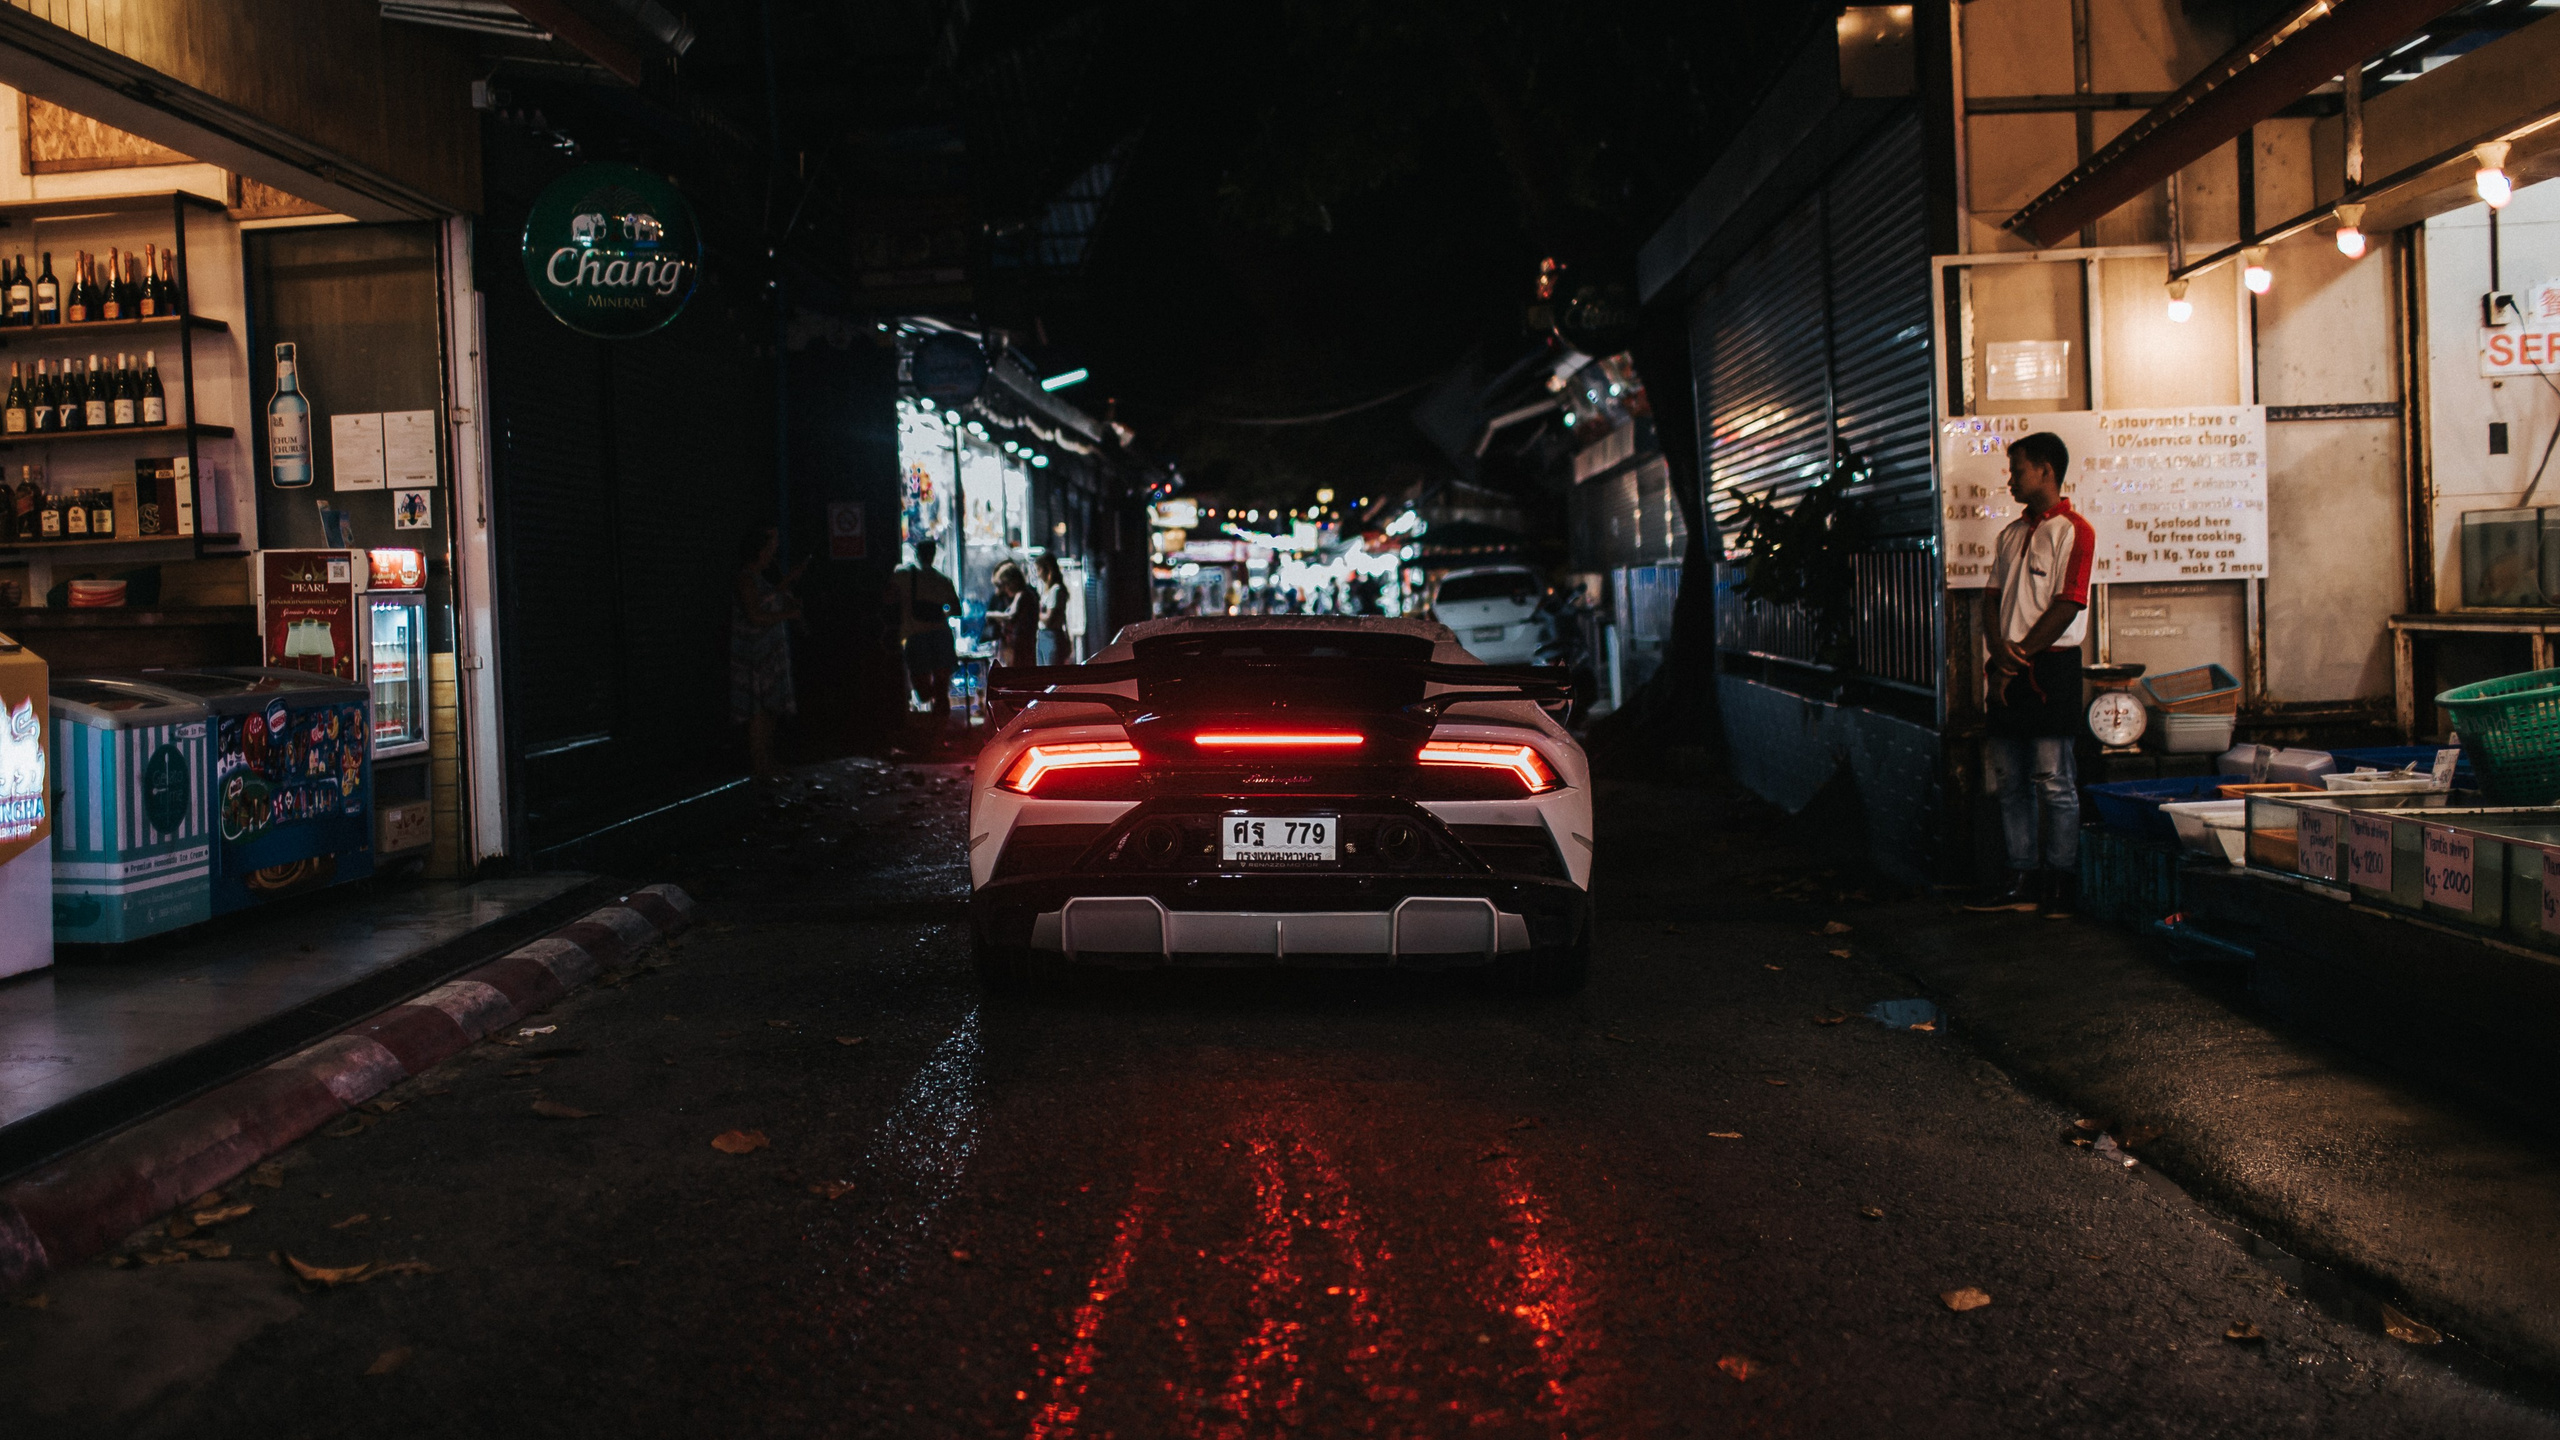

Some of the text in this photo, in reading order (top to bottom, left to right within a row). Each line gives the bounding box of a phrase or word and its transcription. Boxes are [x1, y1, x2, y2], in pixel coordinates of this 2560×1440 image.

[547, 247, 682, 295] Chang
[588, 295, 647, 308] MINERAL
[273, 436, 298, 444] CHUM
[2126, 516, 2231, 531] Buy Seafood here
[2148, 530, 2246, 544] for free cooking.
[1968, 543, 1990, 558] Kg.
[2126, 550, 2148, 564] Buy
[2163, 549, 2183, 563] Kg.
[2188, 548, 2209, 559] You
[2215, 550, 2235, 559] can
[1948, 564, 1978, 576] Next
[2181, 562, 2263, 574] make 2 menu
[291, 583, 329, 593] PEARL
[1285, 822, 1326, 845] 779
[2443, 868, 2471, 894] 2000
